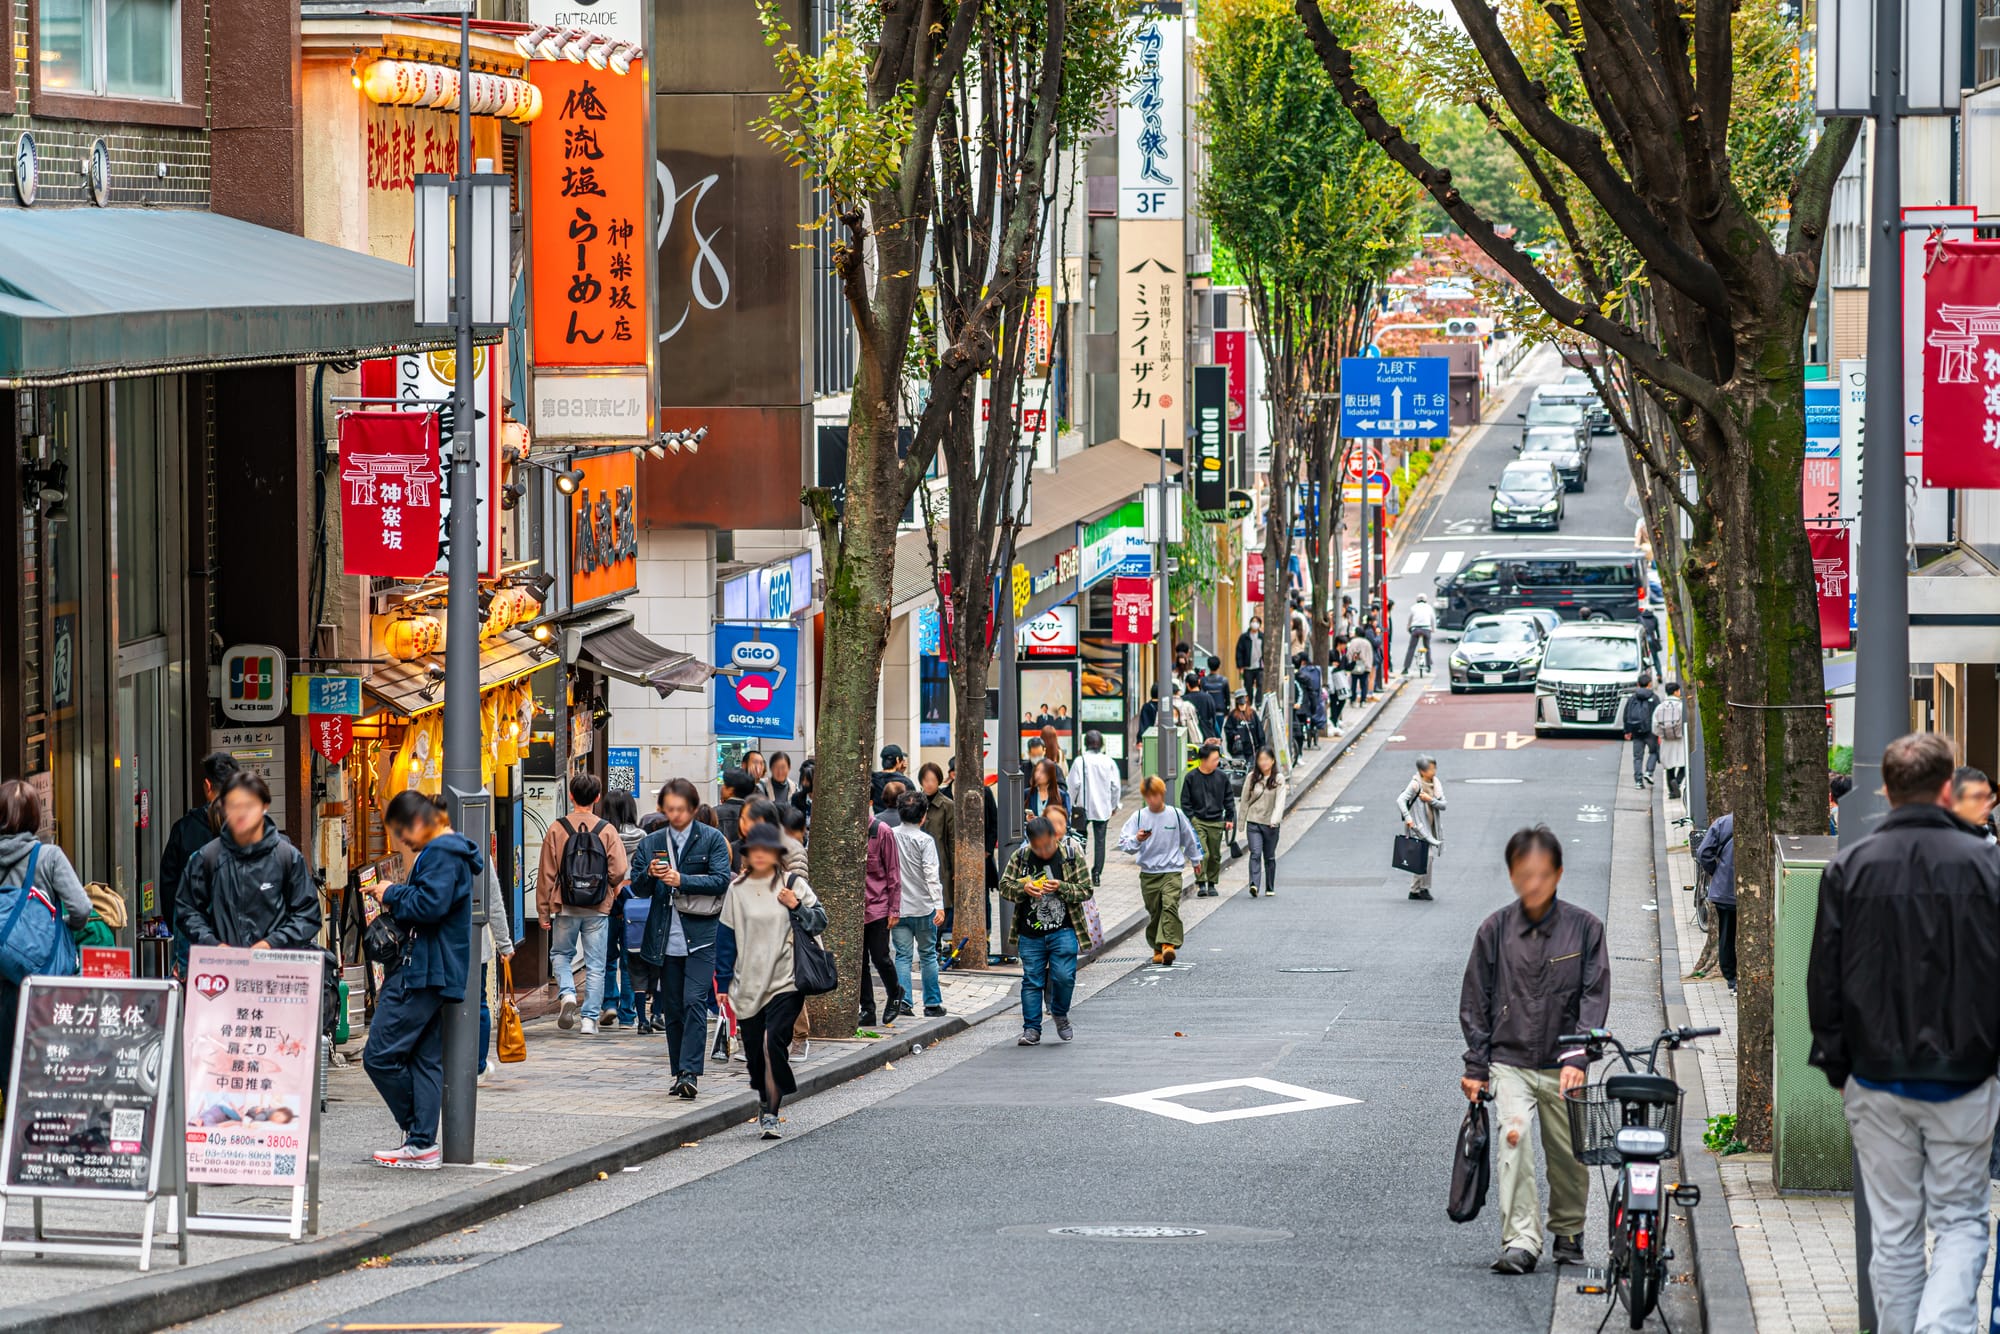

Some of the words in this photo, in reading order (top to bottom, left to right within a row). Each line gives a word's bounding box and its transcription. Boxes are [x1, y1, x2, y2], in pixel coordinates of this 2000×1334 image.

[555, 11, 618, 26] ENTRAIDE
[1136, 192, 1166, 213] 3F
[559, 79, 608, 344] 俺流塩らーめん
[607, 217, 637, 341] 神楽坂店
[1130, 283, 1154, 409] ミライザカ
[1376, 361, 1417, 375] 九段下
[1376, 375, 1417, 383] Kudanshita
[1344, 394, 1381, 407] 飯田橋
[1413, 393, 1445, 407] 市谷
[542, 398, 640, 418] 第83東京ビル
[1346, 407, 1379, 416] Iidabashi
[1414, 408, 1444, 417] Ichigaya
[1808, 461, 1835, 487] 靴
[379, 482, 403, 550] 神楽坂
[769, 569, 792, 620] GiGO
[1029, 622, 1063, 630] スシロー
[1128, 605, 1138, 634] 神楽坂
[737, 647, 775, 660] GiGO
[230, 673, 272, 685] JCB
[230, 703, 256, 711] JCB
[256, 703, 274, 711] CARDS
[728, 713, 755, 724] GiGO
[756, 716, 781, 726] 神楽坂
[332, 715, 344, 750] ペイペイ
[320, 721, 333, 760] 使えます。
[1463, 731, 1537, 750] 40
[528, 787, 545, 800] 2F
[52, 1002, 145, 1030] 漢方整体
[236, 1008, 264, 1021] 整体
[220, 1025, 277, 1039] 骨盤矯正
[46, 1045, 70, 1058] 整体
[227, 1042, 267, 1055] 肩こり
[44, 1063, 108, 1077] オイルマッサージ
[231, 1060, 260, 1073] 腰痛
[216, 1077, 273, 1091] 中国推拿
[207, 1132, 227, 1146] 40分
[230, 1135, 256, 1145] 6800円
[267, 1136, 299, 1148] 3800円
[67, 1166, 136, 1179] 03-6265-3281
